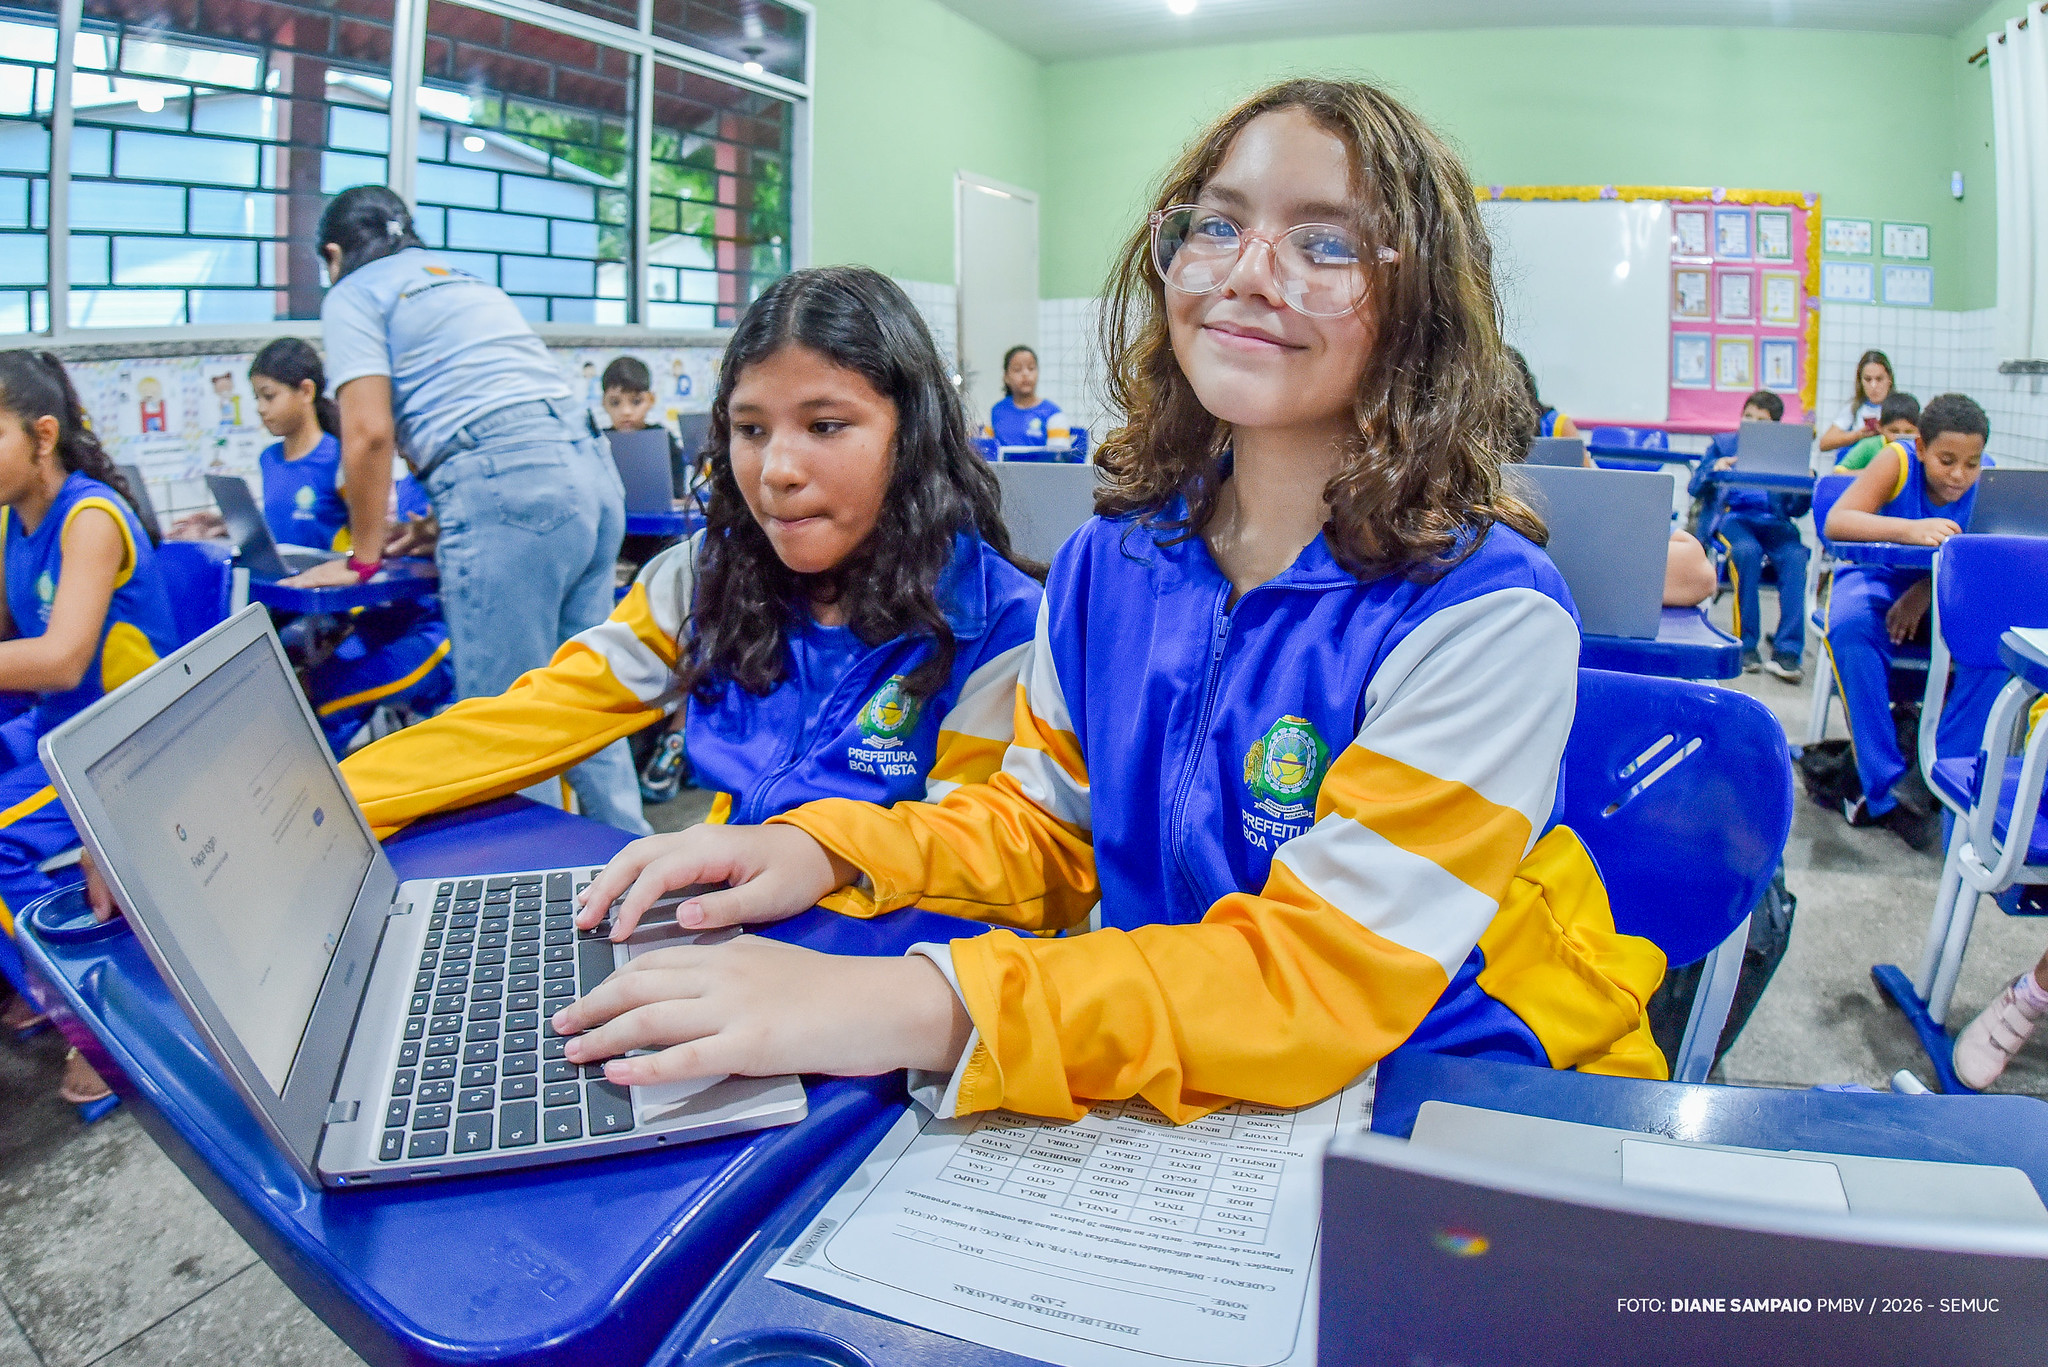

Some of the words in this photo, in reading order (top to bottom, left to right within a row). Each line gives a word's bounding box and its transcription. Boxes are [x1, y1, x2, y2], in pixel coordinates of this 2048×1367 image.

[848, 747, 917, 762] PREFEITURA
[849, 760, 875, 775] BOA
[880, 764, 917, 776] VISTA
[1242, 809, 1311, 839] PREFEITU
[1243, 824, 1268, 851] BOA
[998, 1116, 1027, 1126] LIVRO
[1247, 1120, 1281, 1129] VAPINO
[985, 1125, 1026, 1138] GALINHA
[1042, 1125, 1097, 1140] BEIJA-FLOR
[1186, 1124, 1220, 1133] BINATO
[1242, 1132, 1279, 1141] FAVOPE
[982, 1139, 1012, 1149] NAVIO
[1048, 1139, 1080, 1149] COBRA
[1109, 1138, 1149, 1149] GUARDA
[1168, 1148, 1212, 1159] QUINTAL
[1236, 1145, 1268, 1154] malucas
[1270, 1150, 1304, 1158] Palavras
[970, 1149, 1008, 1162] GUERRA
[1030, 1149, 1082, 1163] BOMBEIRO
[1105, 1150, 1141, 1160] GIRAFA
[969, 1162, 993, 1172] CASA
[1168, 1161, 1202, 1171] DENTE
[1229, 1157, 1276, 1168] HOSPITAL
[1032, 1164, 1064, 1174] QUILO
[1100, 1163, 1134, 1173] BARCO
[954, 1174, 989, 1186] CAMPO
[1092, 1175, 1129, 1186] QUEIJO
[1232, 1171, 1264, 1180] PENTE
[1027, 1176, 1055, 1186] GATO
[1020, 1189, 1048, 1199] BOLA
[1090, 1189, 1119, 1199] DADO
[1154, 1187, 1195, 1197] HOMEM
[1232, 1185, 1257, 1193] GUIA
[1078, 1201, 1118, 1214] PANELA
[1154, 1201, 1185, 1211] TINTA
[1227, 1198, 1254, 1207] HOJE
[976, 1208, 1016, 1221] conseguiu
[1050, 1213, 1086, 1226] palavras
[1217, 1212, 1254, 1222] VENTO
[1149, 1215, 1177, 1225] VASO
[1035, 1222, 1058, 1231] aluno
[1217, 1227, 1246, 1236] FACA
[1085, 1233, 1137, 1248] ortográficas
[1161, 1235, 1183, 1243] meta
[958, 1243, 984, 1255] DATA
[1192, 1241, 1227, 1251] verdade
[1139, 1244, 1192, 1259] dificuldades
[1242, 1249, 1281, 1259] Palavras
[1094, 1254, 1147, 1269] ortográficas
[1206, 1256, 1240, 1267] Marque
[1150, 1264, 1204, 1280] Dificuldades
[1244, 1261, 1294, 1275] Instruções:
[1221, 1278, 1276, 1292] CADERNO
[953, 1285, 1009, 1304] PALAVRAS
[1011, 1300, 1025, 1309] DE
[1210, 1298, 1249, 1310] NOME:
[1029, 1304, 1076, 1321] LEITURA
[1197, 1306, 1246, 1321] ESCOLA:
[1078, 1316, 1093, 1325] DE
[1104, 1323, 1140, 1335] TESTE
